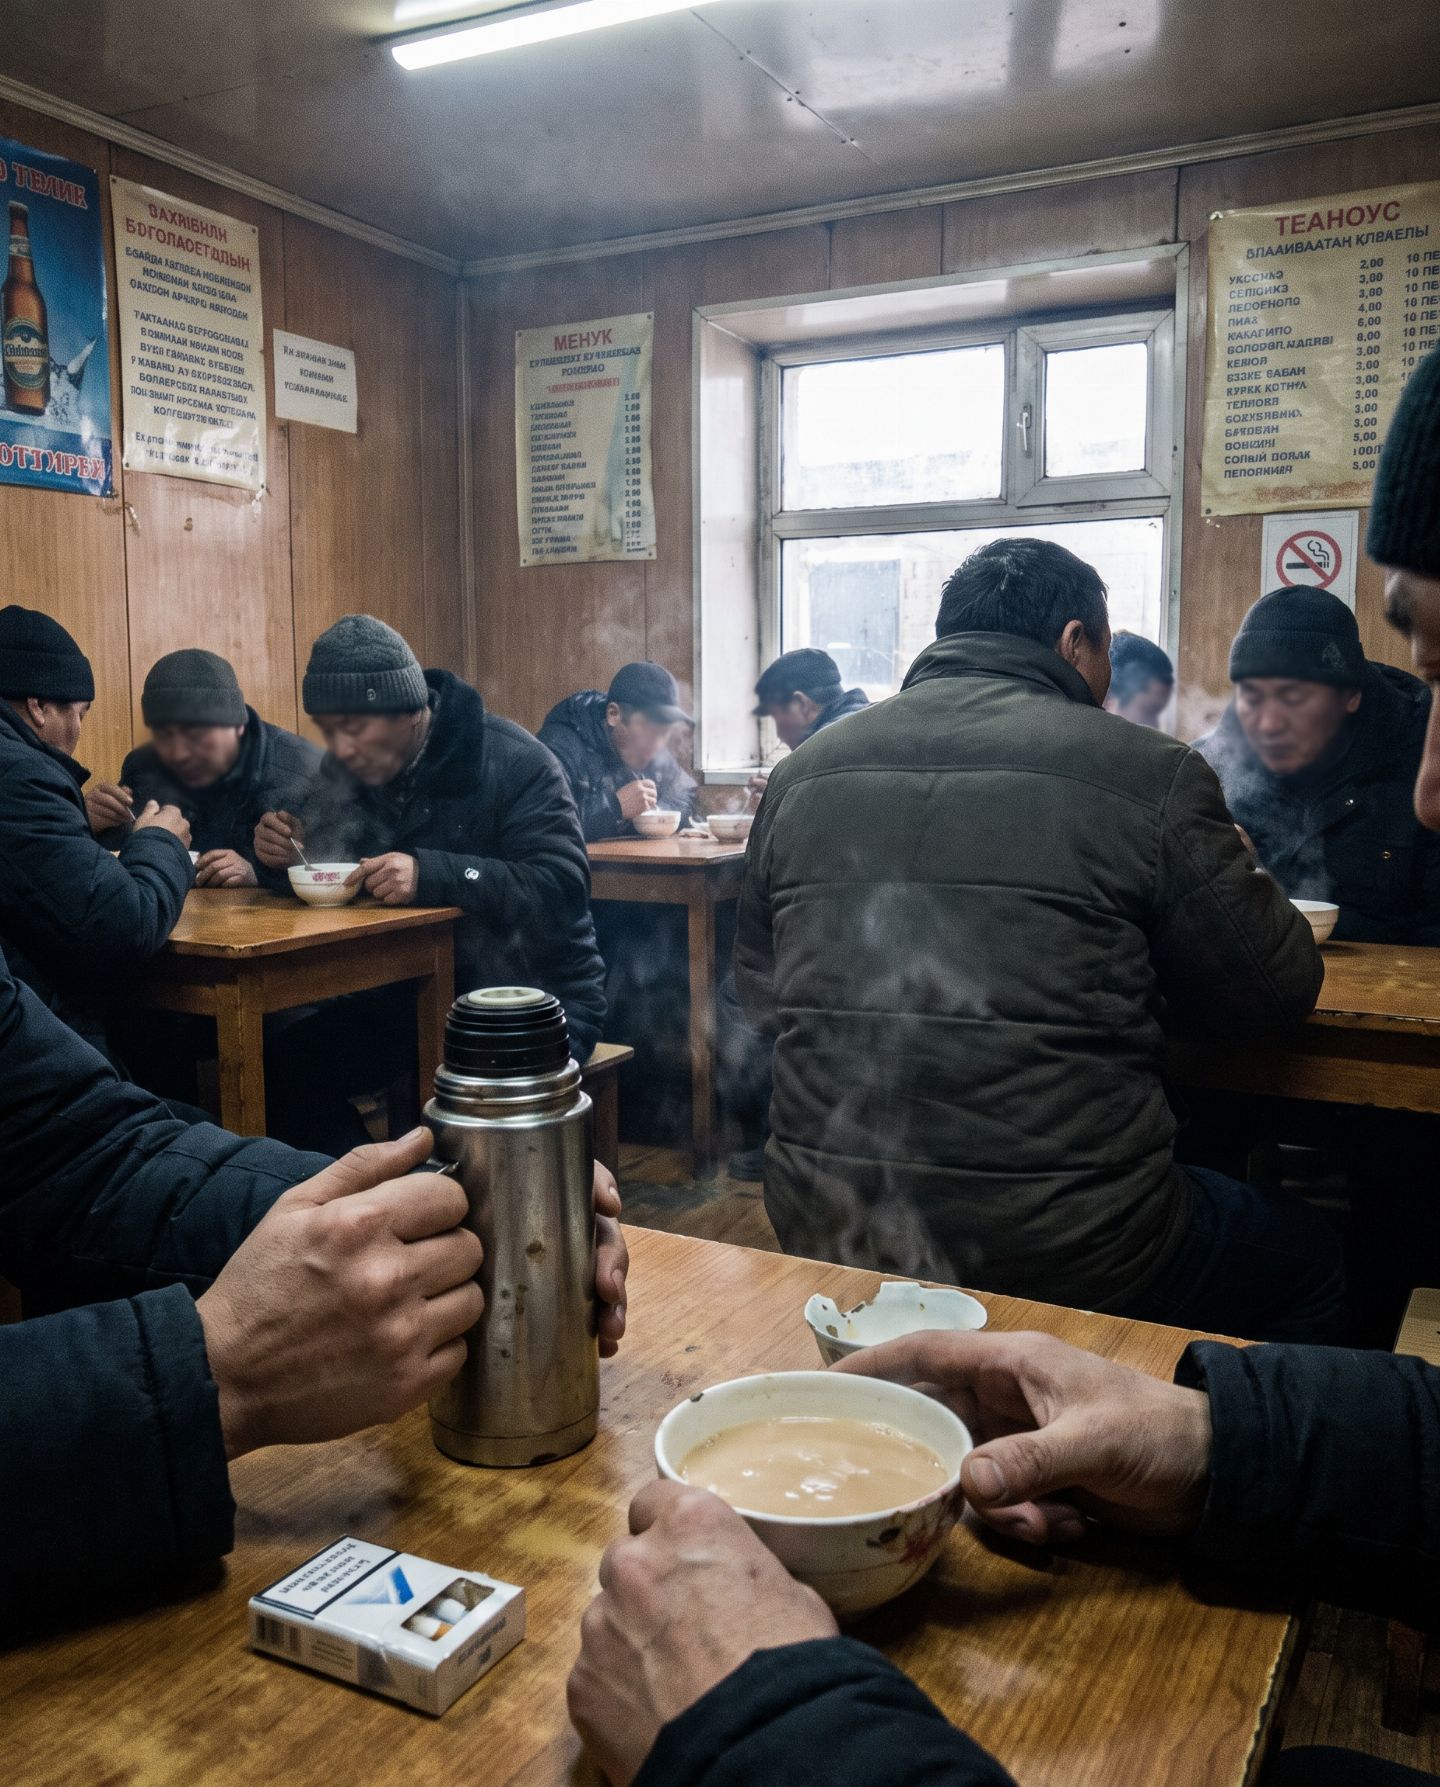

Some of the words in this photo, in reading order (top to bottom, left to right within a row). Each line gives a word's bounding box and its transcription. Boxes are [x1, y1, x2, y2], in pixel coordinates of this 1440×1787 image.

[1275, 201, 1401, 236] ТЕАНОУС
[1407, 253, 1420, 264] 10
[1406, 268, 1419, 278] 10
[1405, 283, 1418, 293] 10
[1404, 298, 1417, 308] 10
[1403, 312, 1417, 322] 10
[1403, 327, 1416, 337] 10
[554, 328, 612, 351] МЕНУК
[1402, 342, 1415, 352] 10
